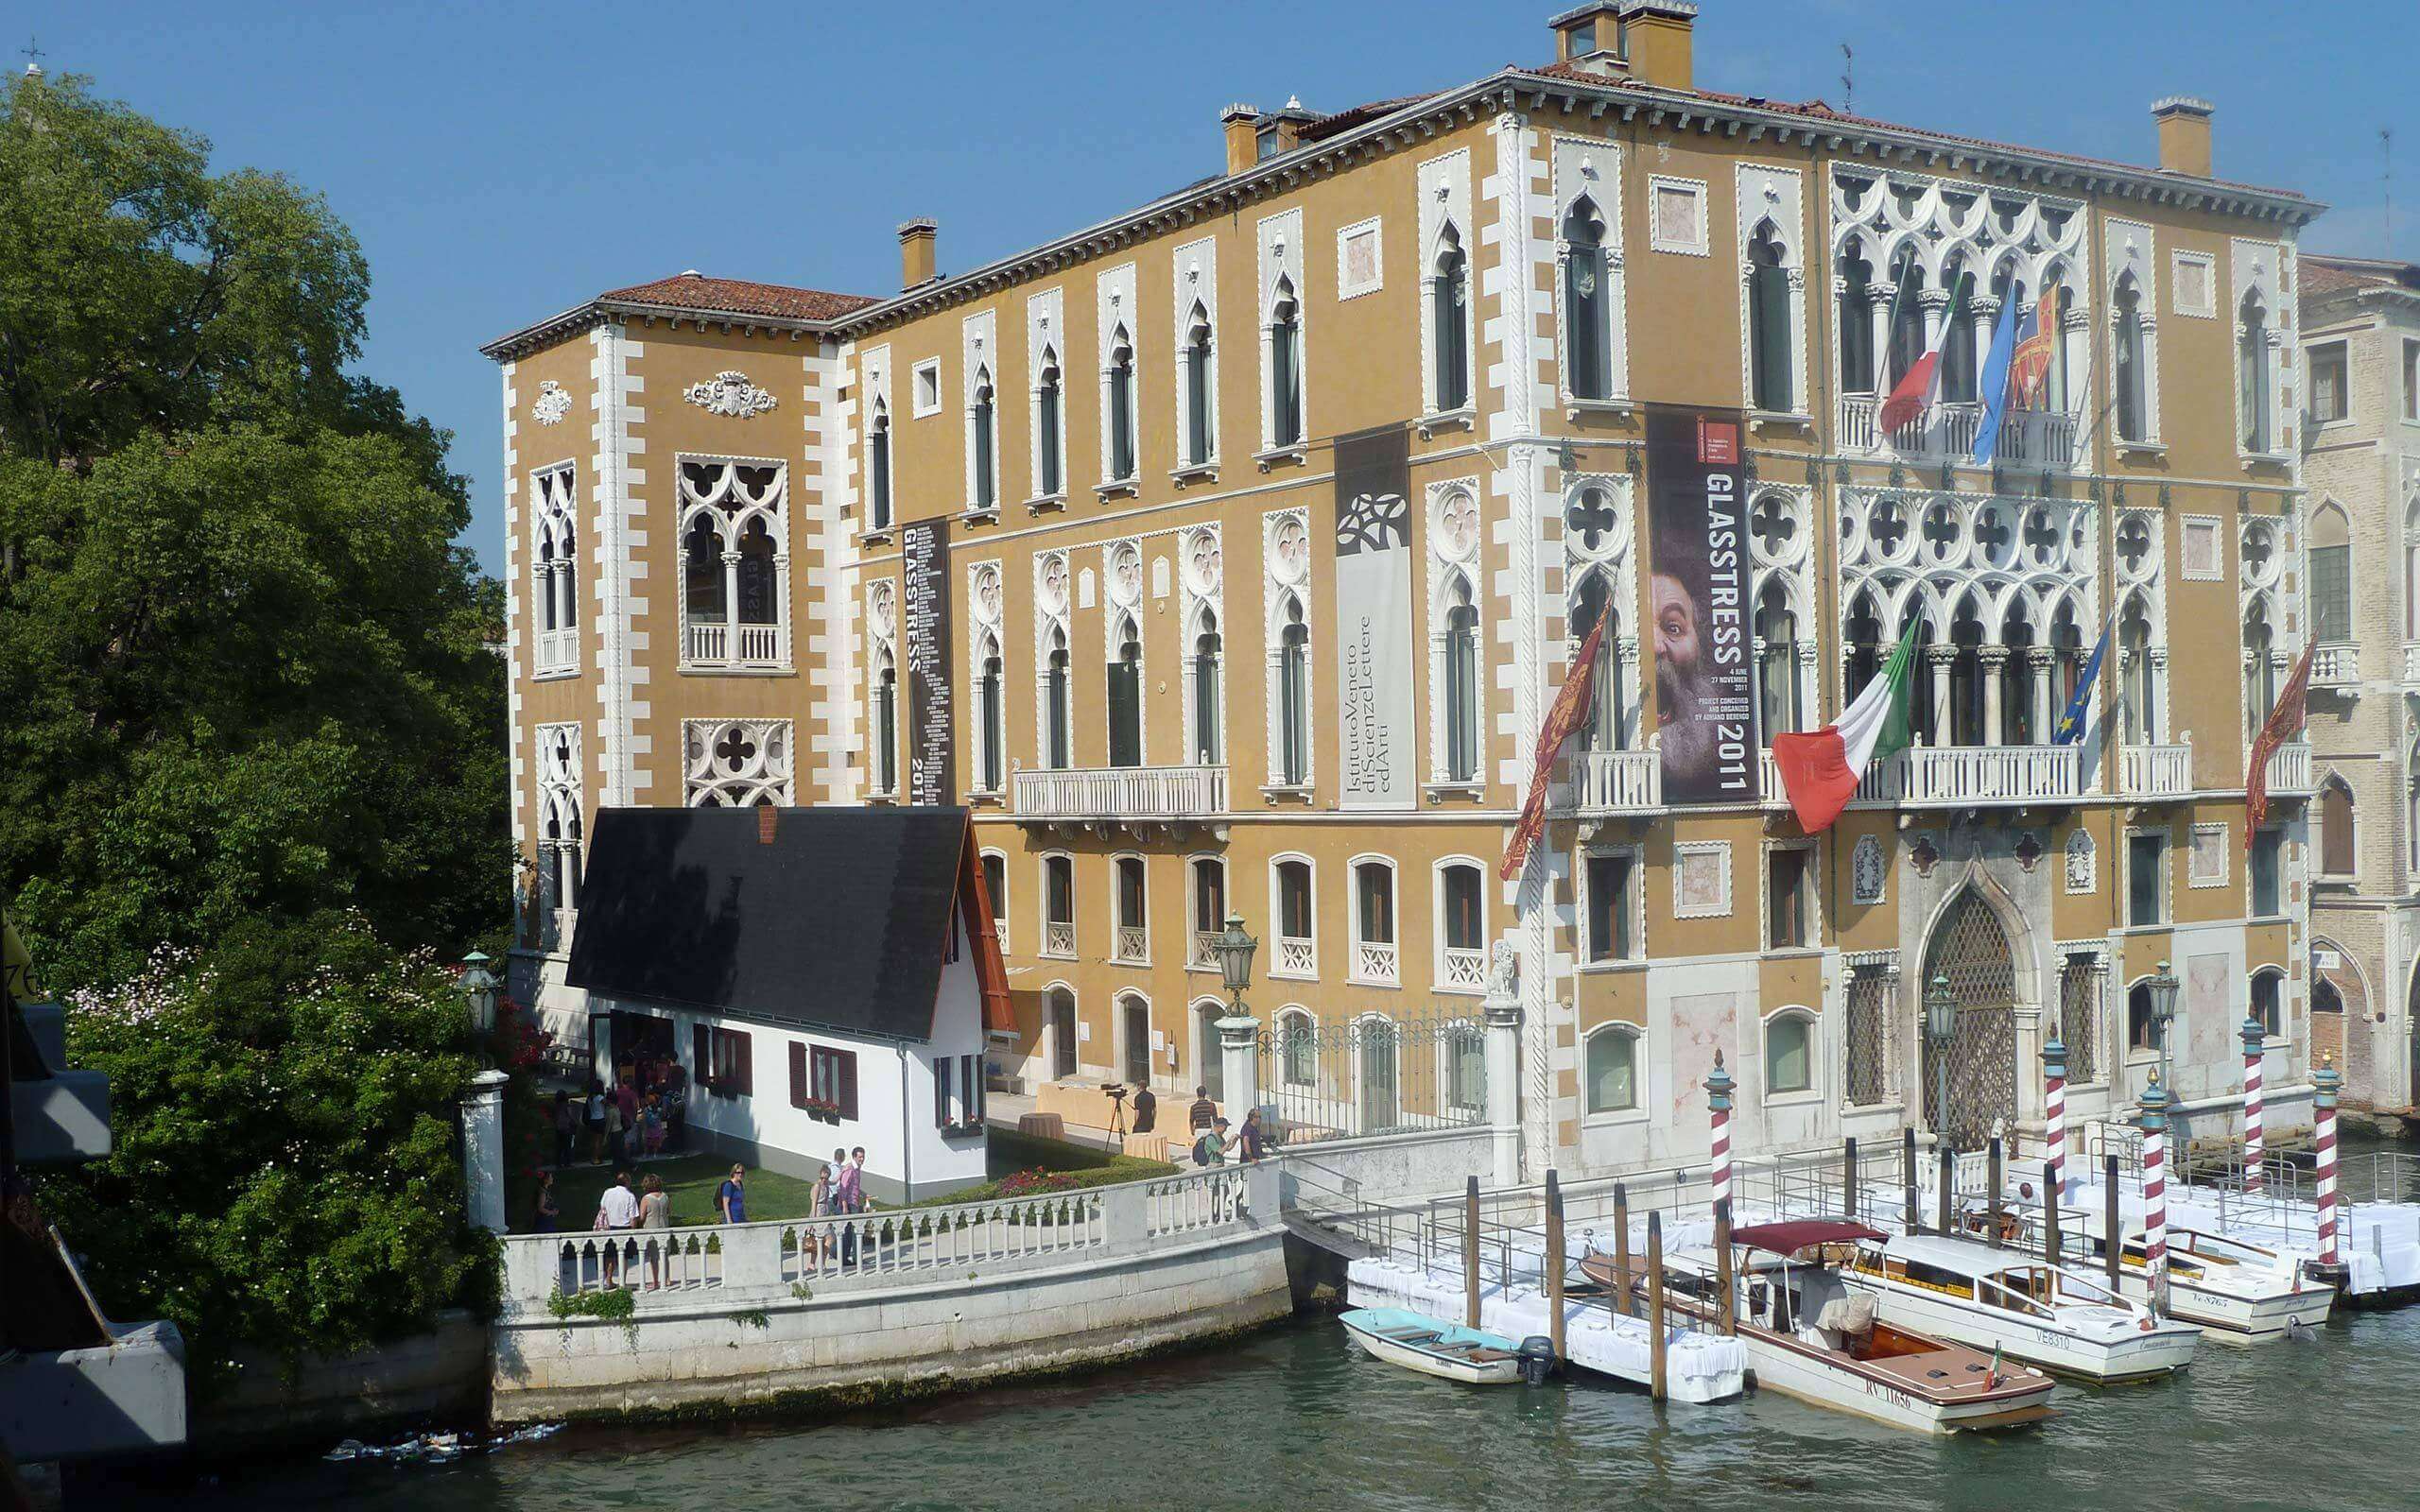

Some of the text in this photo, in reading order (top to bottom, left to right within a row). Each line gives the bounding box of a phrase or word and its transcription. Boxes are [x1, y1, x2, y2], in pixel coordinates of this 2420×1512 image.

[1706, 472, 1742, 664] GLASSTRESS
[904, 528, 921, 673] GLASSTRESS
[911, 758, 925, 806] 2011
[1717, 724, 1745, 790] 2011
[2035, 1330, 2070, 1349] VE8310
[1885, 1388, 1911, 1409] 11656
